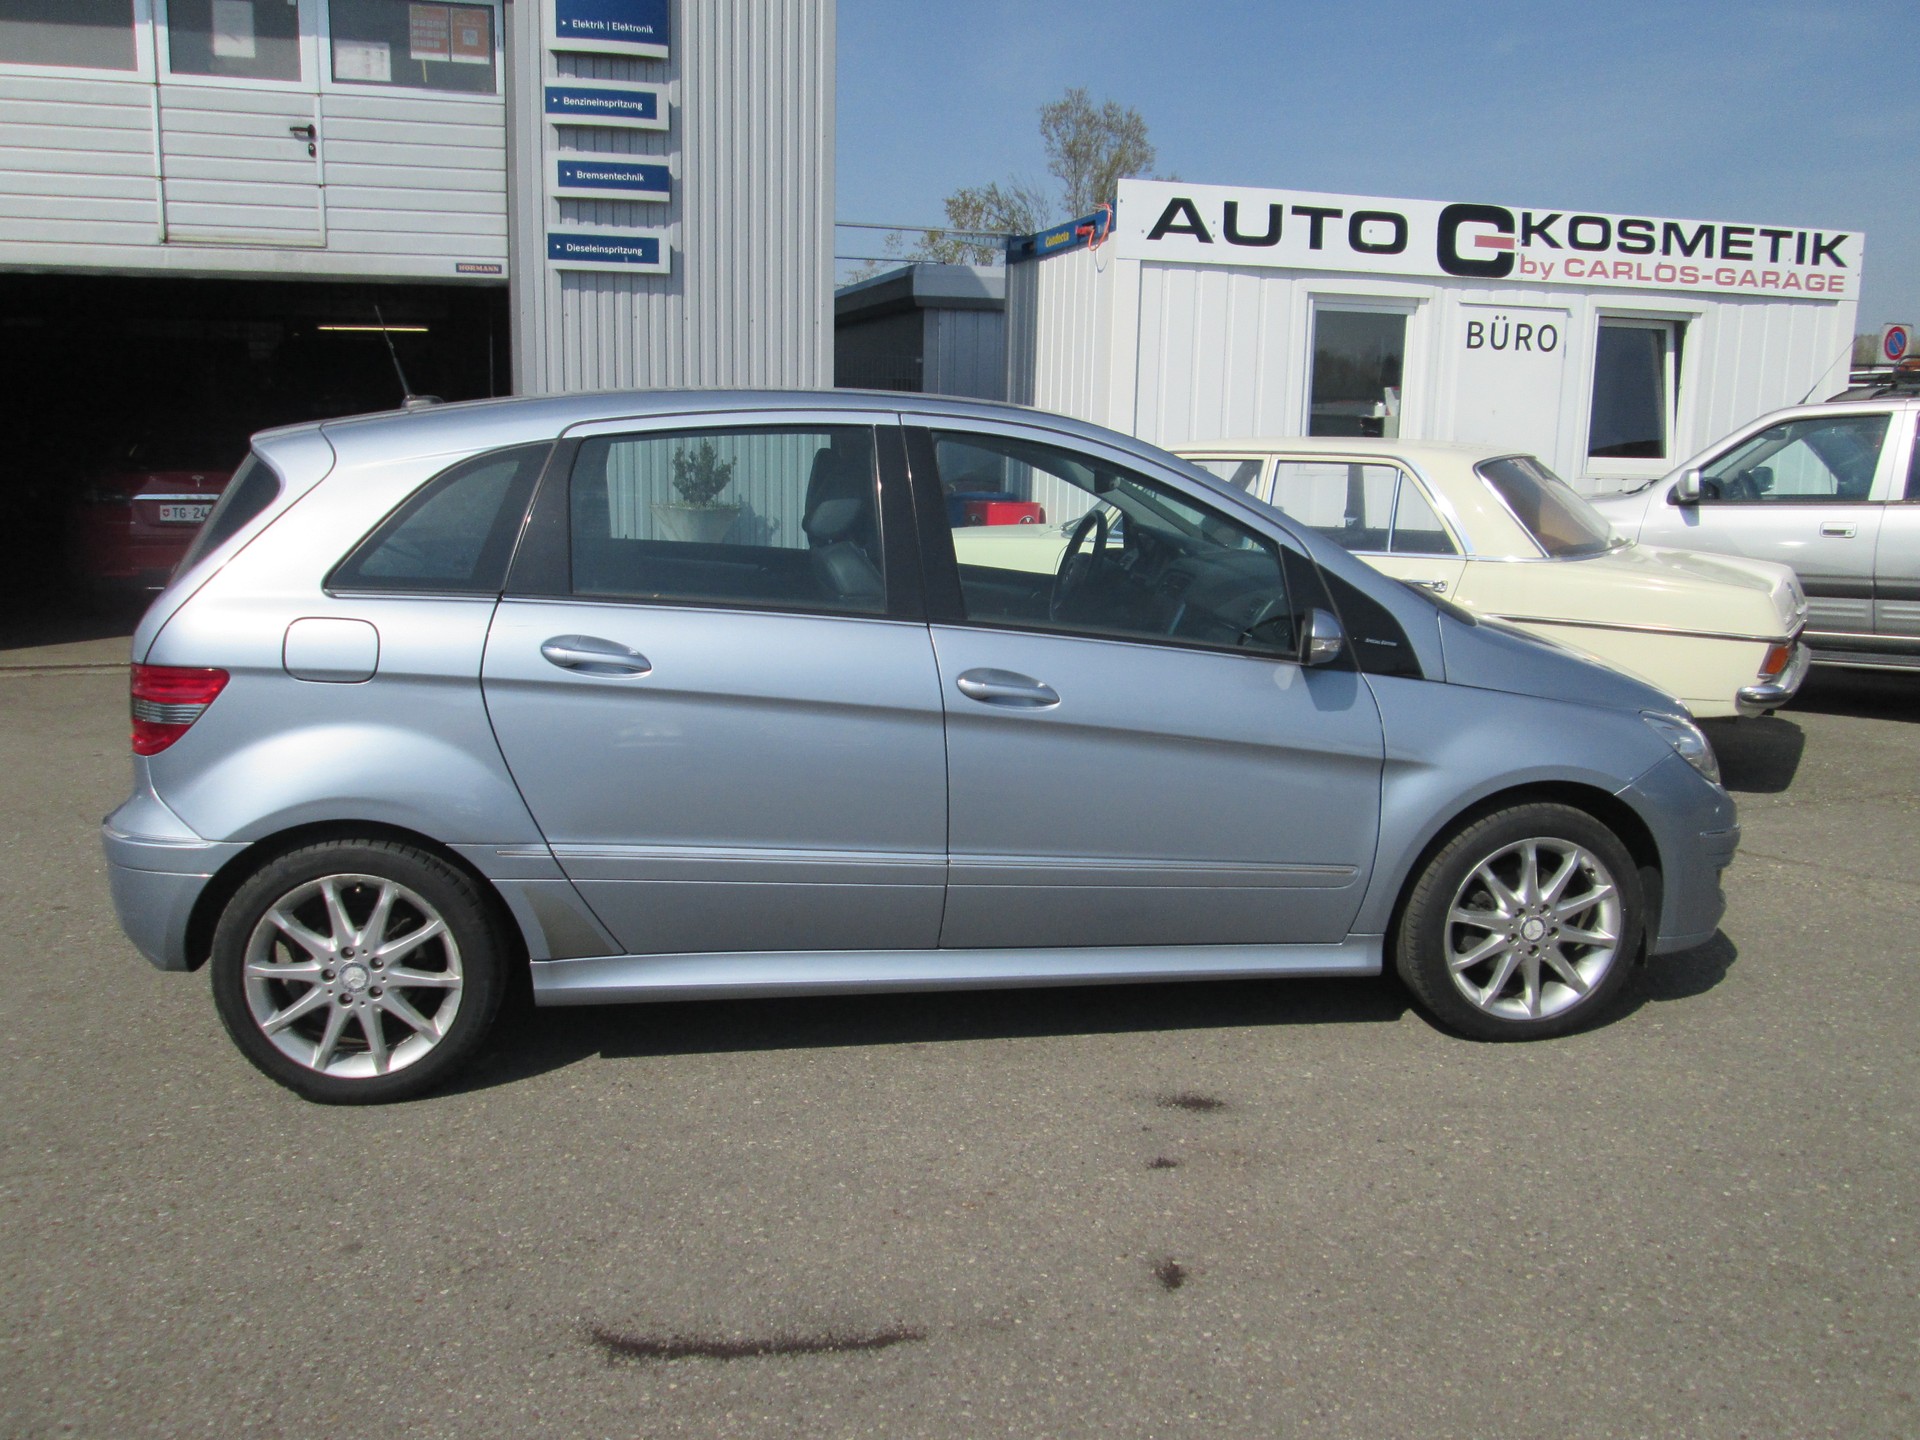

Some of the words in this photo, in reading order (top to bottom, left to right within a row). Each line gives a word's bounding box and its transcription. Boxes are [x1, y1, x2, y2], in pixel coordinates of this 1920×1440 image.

[572, 19, 605, 30] Elektrik
[612, 22, 654, 34] Elektronik
[563, 96, 643, 111] Benzineinspritzung
[576, 170, 645, 182] Bremsentechnik
[1146, 197, 1409, 255] AUTO
[1521, 211, 1850, 268] KOSMETIK
[566, 243, 643, 256] Dieseleinspritzung
[1519, 254, 1555, 281] by
[1564, 257, 1846, 293] CARLOS-GARAGE
[1466, 315, 1558, 353] BÜRO
